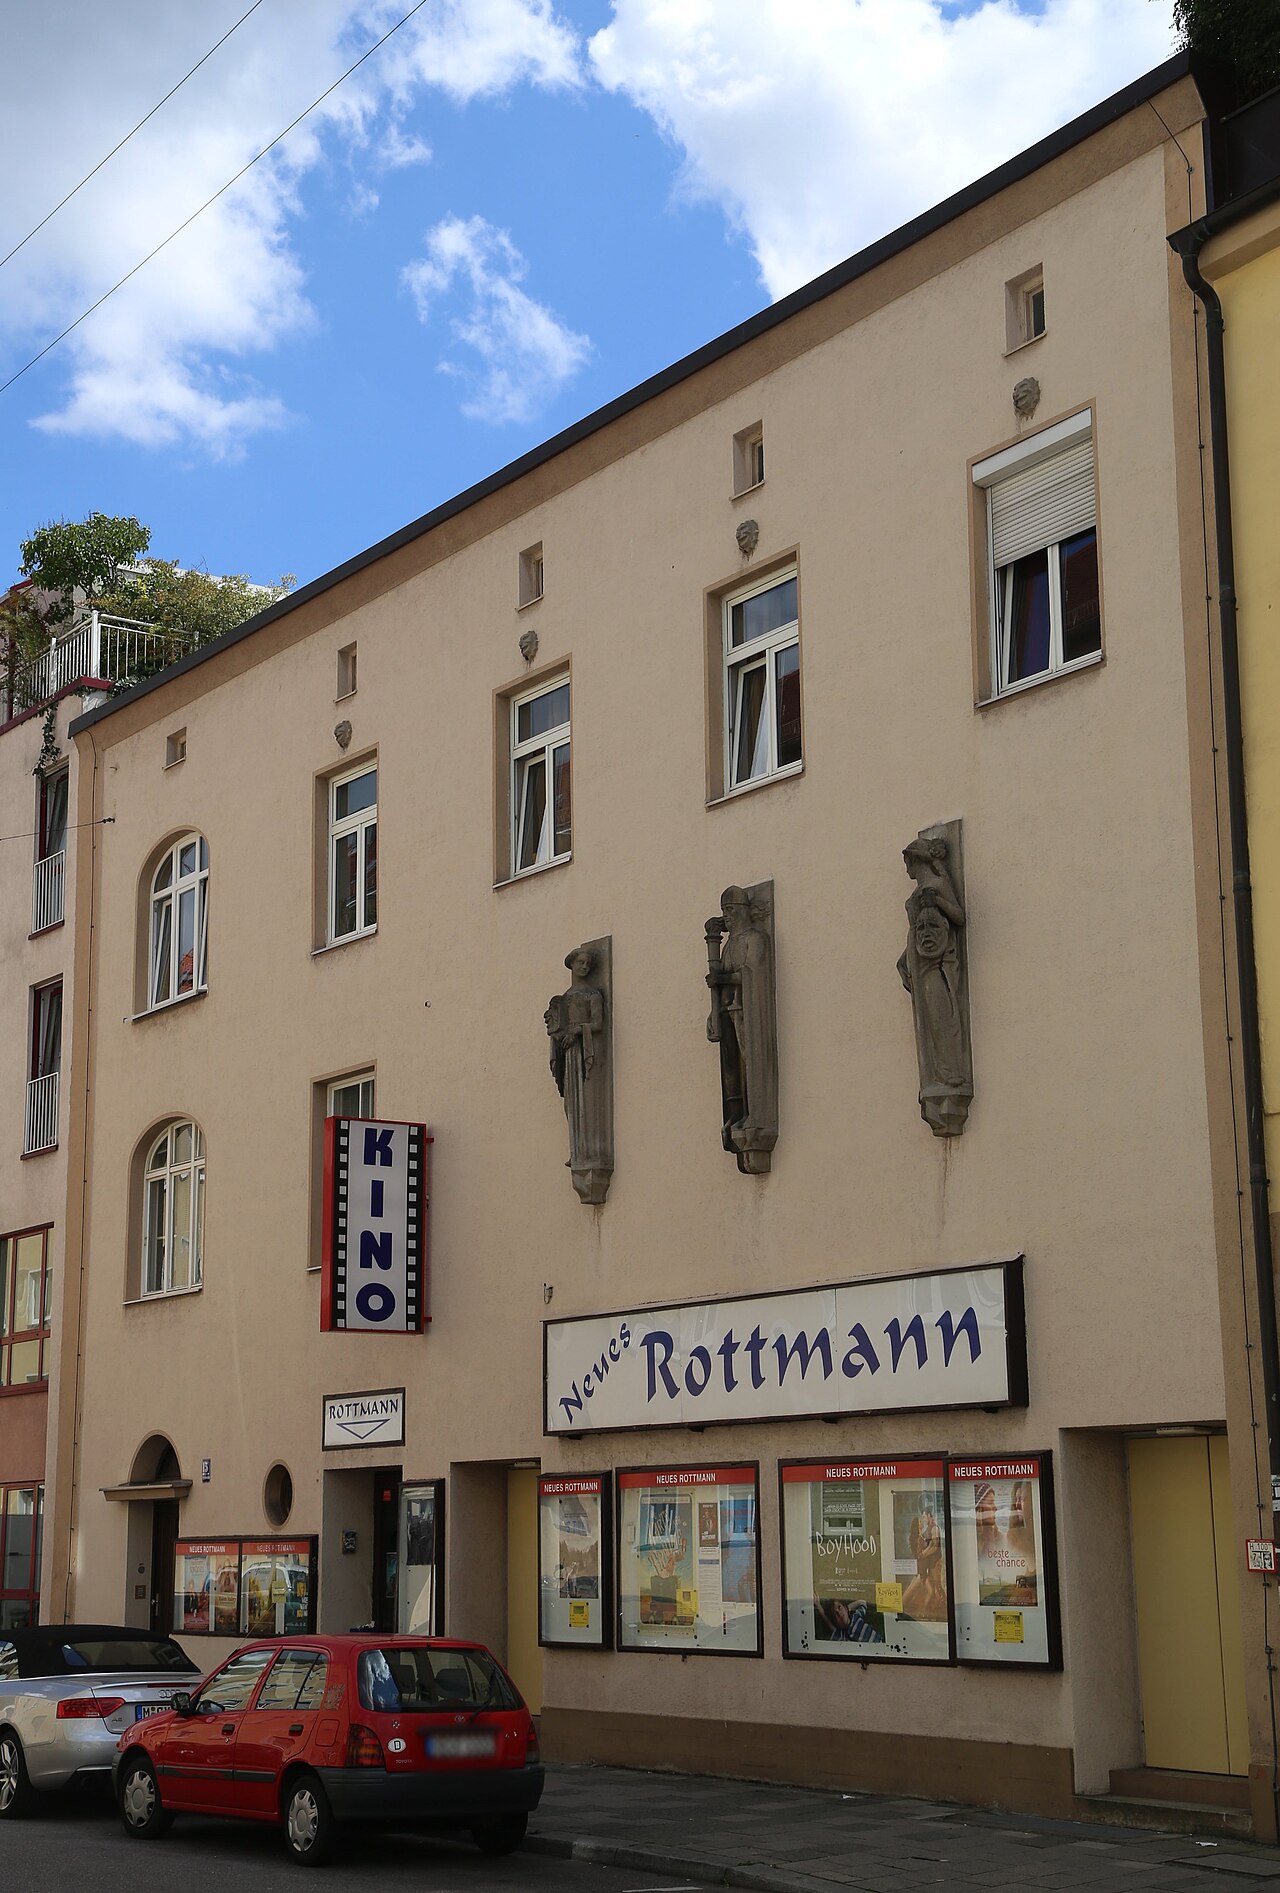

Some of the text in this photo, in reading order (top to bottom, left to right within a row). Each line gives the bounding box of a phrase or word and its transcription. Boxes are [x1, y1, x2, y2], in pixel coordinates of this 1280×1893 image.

[355, 1127, 396, 1323] KINO
[559, 1306, 983, 1424] Neues Rottmann
[329, 1397, 400, 1420] ROTTMANN
[826, 1465, 897, 1478] NEUES ROTTMANN
[954, 1464, 1034, 1477] NEUES ROTTMANN
[656, 1472, 716, 1484] NEUES ROTTMANN
[544, 1482, 598, 1492] NEUES ROTTMANN
[203, 1545, 226, 1553] ROTTMANN
[987, 1549, 1010, 1559] beste
[996, 1558, 1026, 1567] chance
[393, 1740, 401, 1750] D
